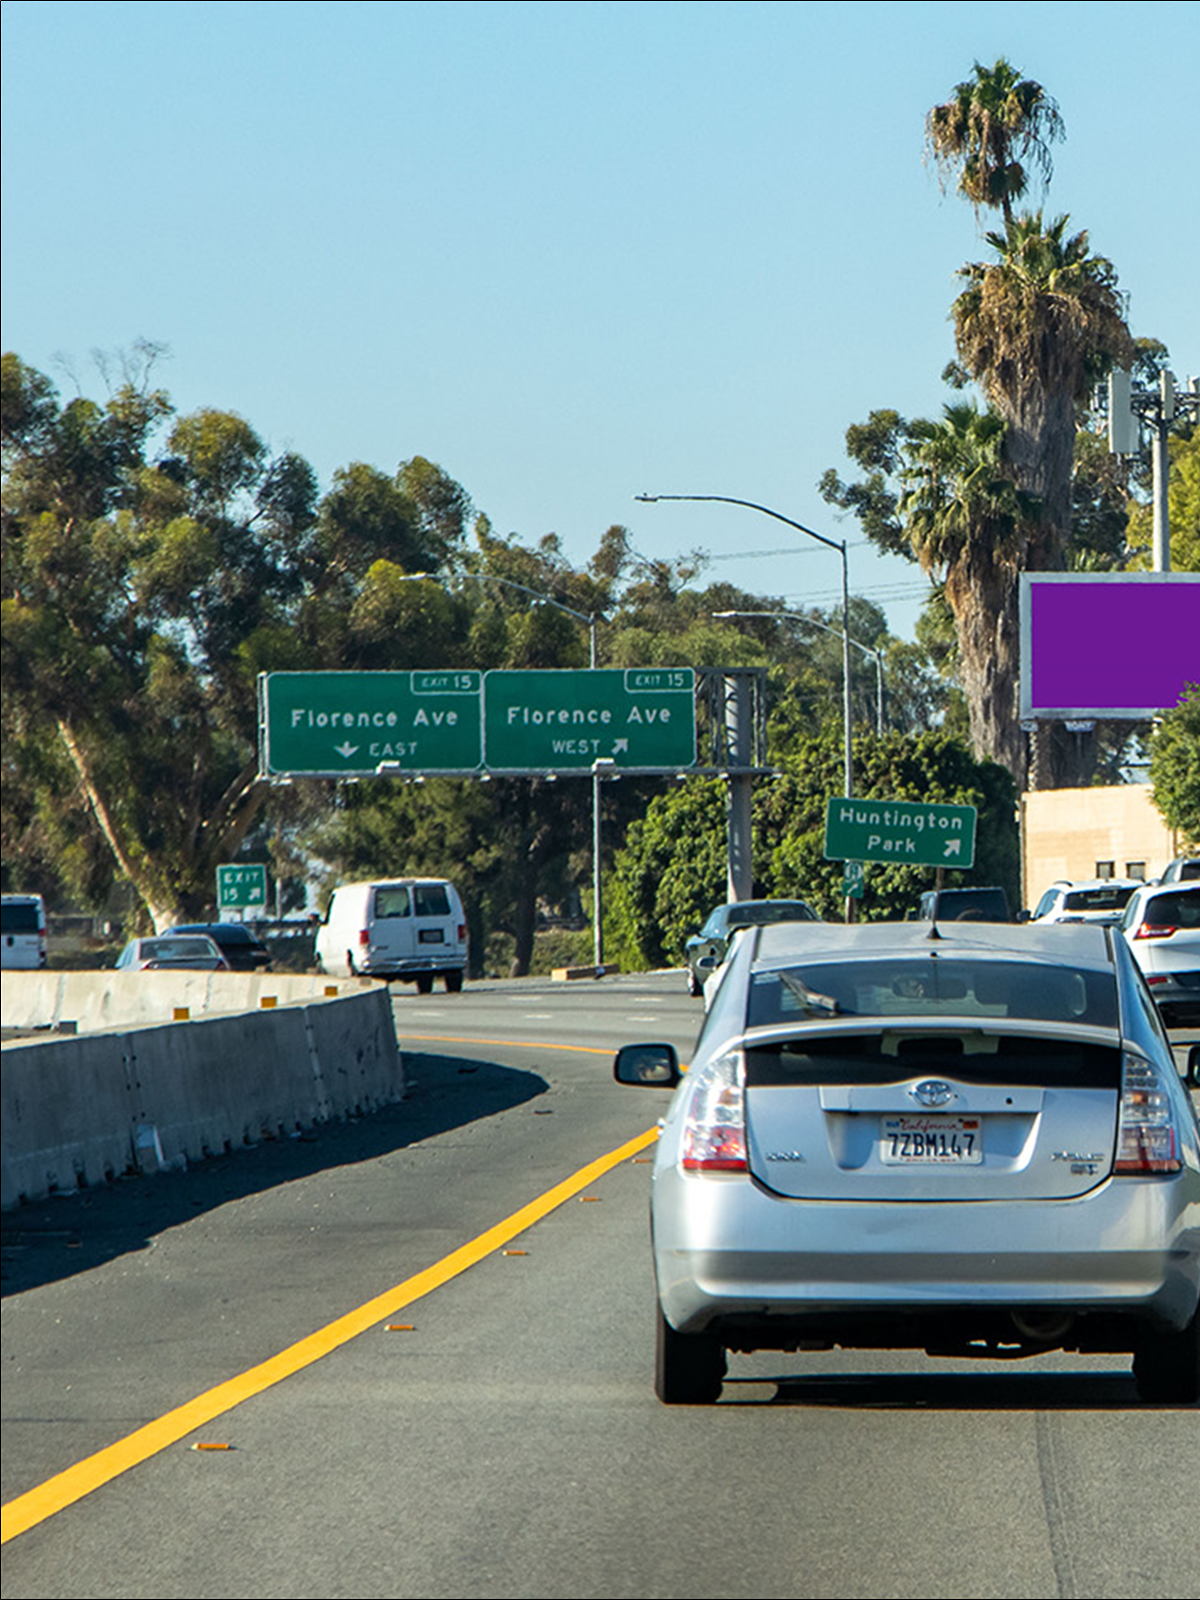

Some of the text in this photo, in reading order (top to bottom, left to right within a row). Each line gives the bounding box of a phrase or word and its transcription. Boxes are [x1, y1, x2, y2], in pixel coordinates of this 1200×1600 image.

[421, 675, 472, 689] EXIT 15
[635, 673, 684, 687] EXIT 15
[290, 707, 459, 729] Florence Ave
[507, 705, 671, 725] Florence Ave
[369, 741, 418, 757] EAST
[552, 739, 600, 755] WEST
[839, 807, 963, 832] Huntington
[867, 835, 916, 853] Park
[223, 871, 260, 884] EXIT
[223, 888, 239, 902] 15
[900, 1119, 963, 1134] California
[887, 1133, 975, 1158] 7ZBM147
